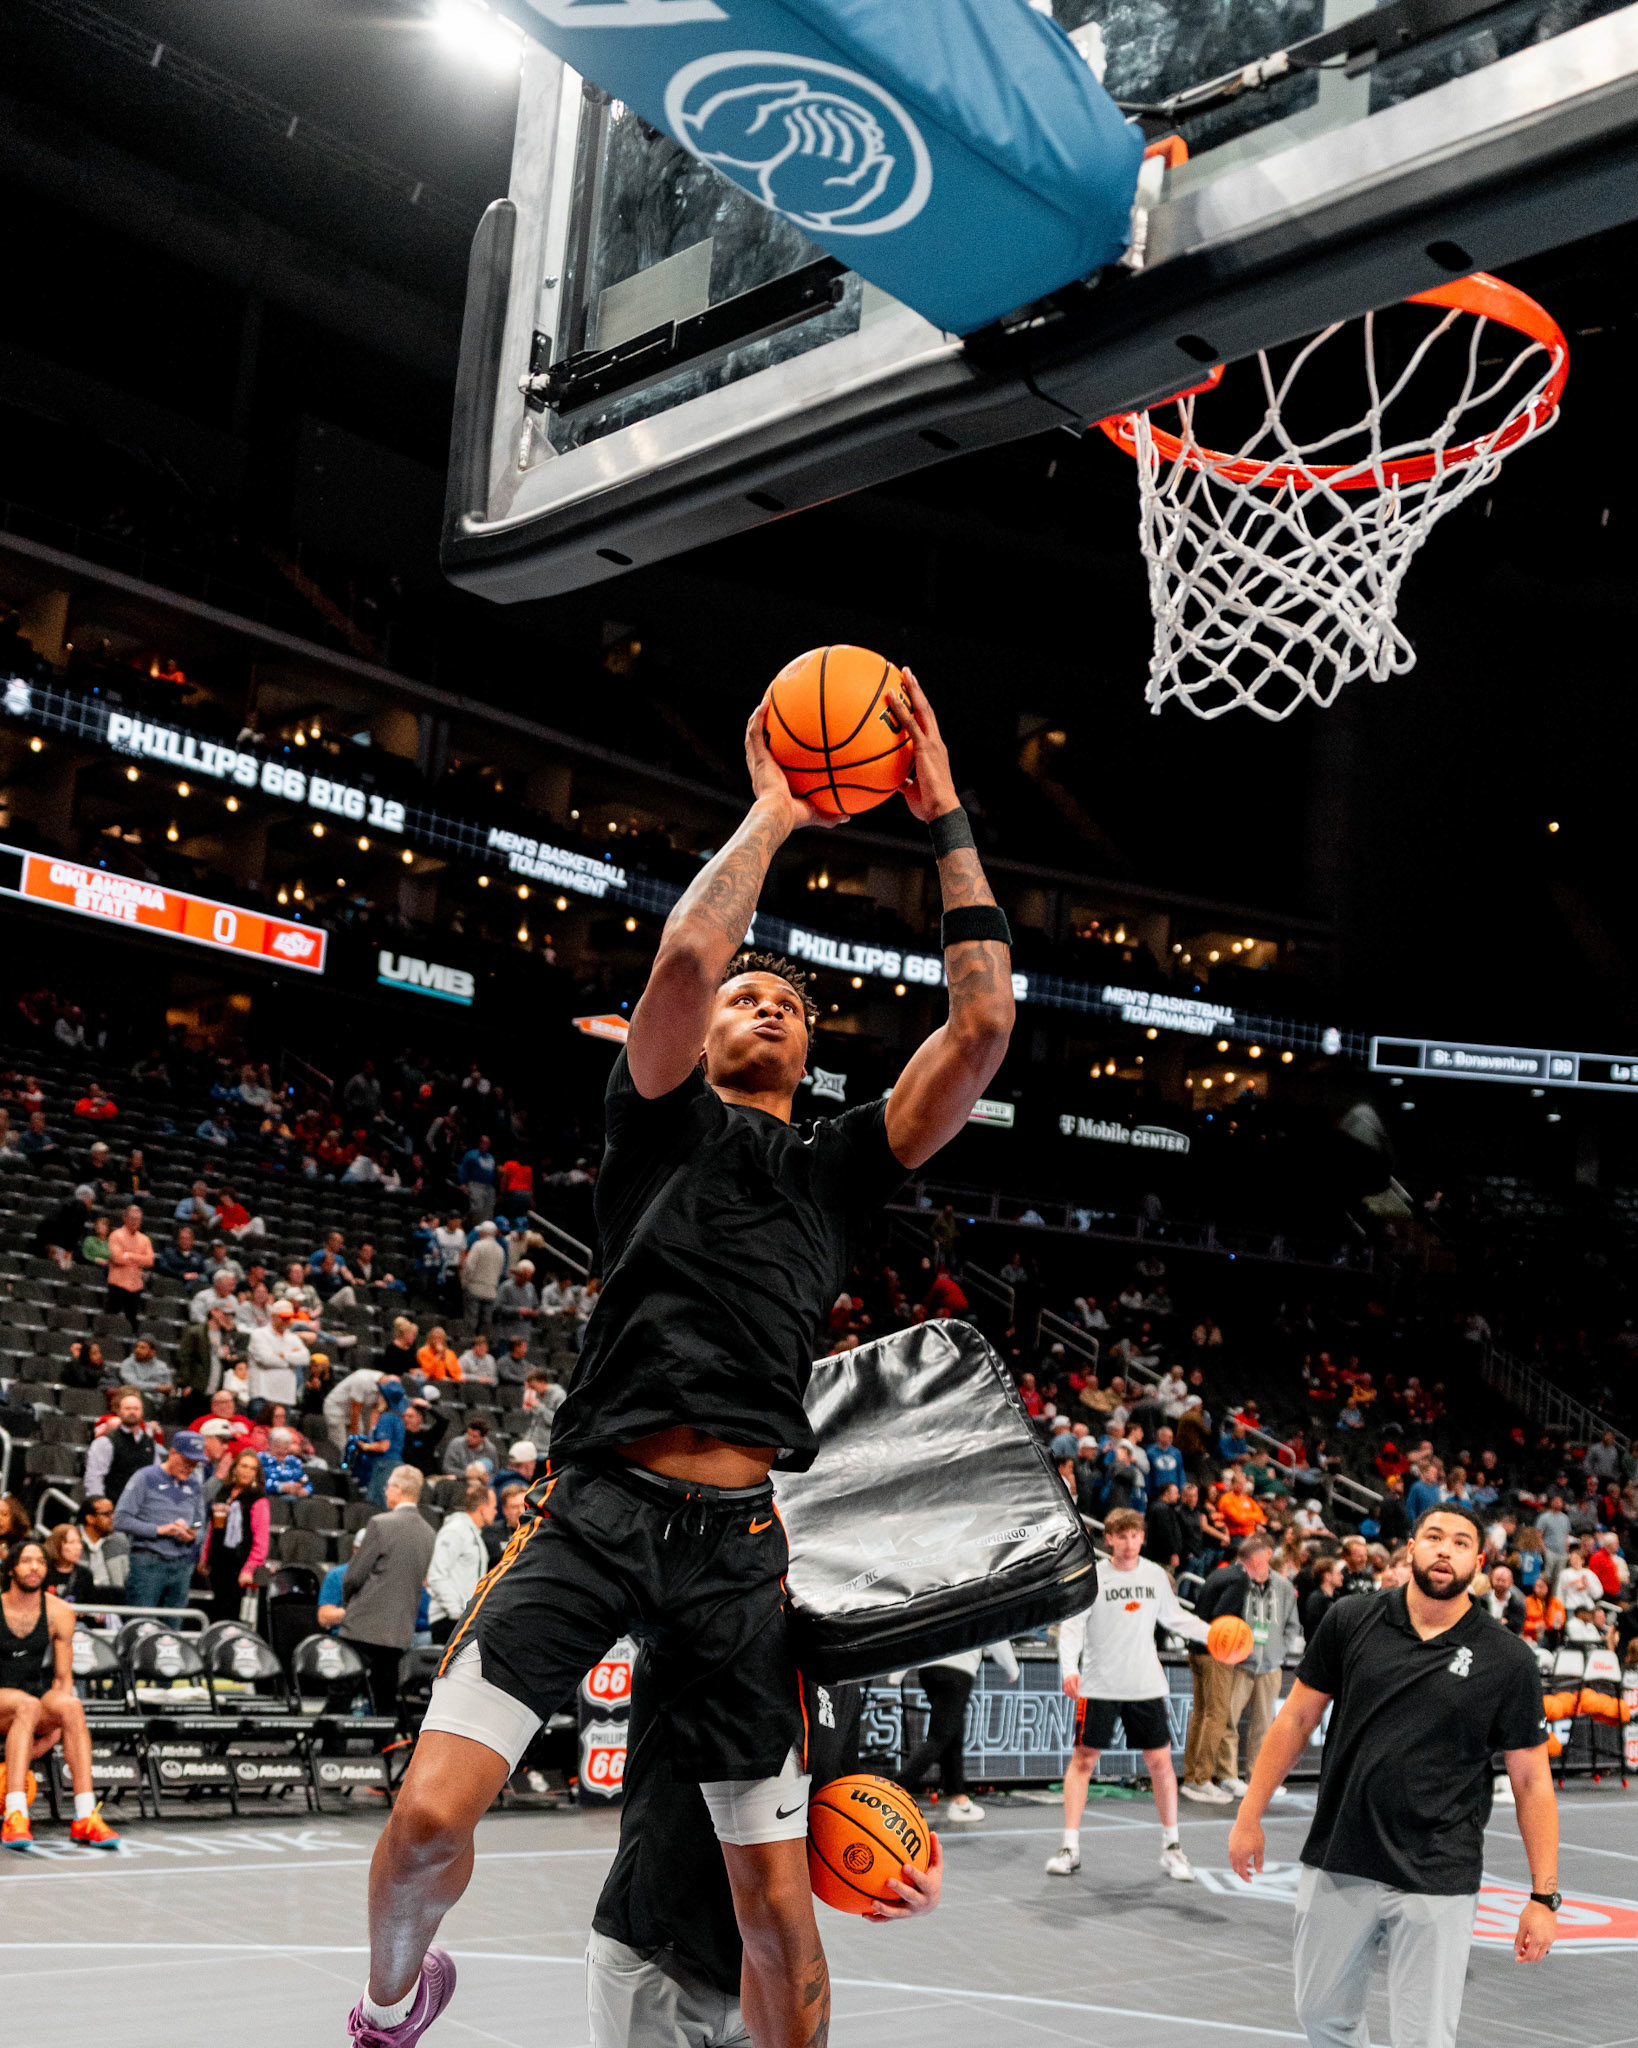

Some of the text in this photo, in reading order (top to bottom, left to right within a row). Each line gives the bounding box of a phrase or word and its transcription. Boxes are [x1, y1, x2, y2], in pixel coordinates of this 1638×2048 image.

[107, 712, 406, 833] PHILLIPS 66 BIG 12
[487, 827, 627, 888] MEN'S BASKETBALL
[50, 864, 165, 911] OKLAHOMA
[508, 852, 610, 898] TOURNAMENT
[74, 888, 138, 921] STATE
[213, 909, 237, 944] 0
[789, 928, 901, 979] PHILLIPS
[903, 954, 942, 985] 66
[378, 950, 475, 998] UMB
[1102, 985, 1235, 1025] MEN'S BASKETBALL
[1121, 1004, 1217, 1036] TOURNAMENT
[1431, 1049, 1538, 1073] St. Bonaventure
[1077, 1116, 1130, 1144] Mobile
[1130, 1129, 1185, 1152] CENTER
[865, 1569, 879, 1585] NC
[1105, 1586, 1156, 1602] LOCK IT IN
[605, 1647, 631, 1660] LLIPS
[593, 1666, 628, 1693] 66
[183, 1763, 228, 1776] Allstate
[259, 1764, 302, 1778] Allstate
[341, 1766, 383, 1779] Allstate
[591, 1751, 626, 1780] 66
[850, 1788, 922, 1862] Wilson
